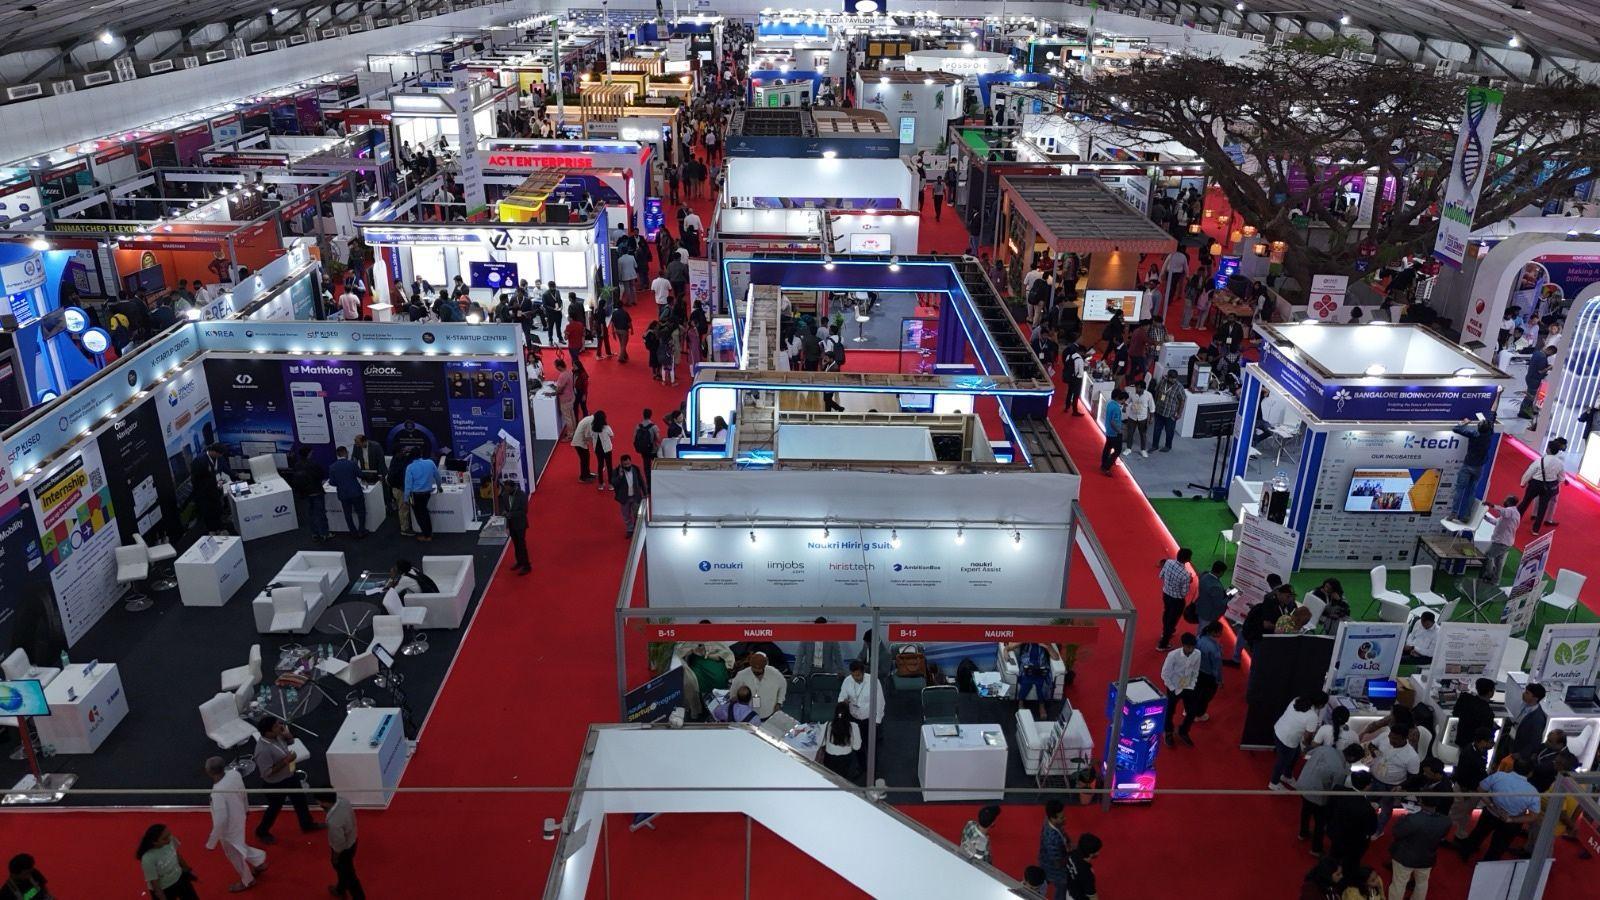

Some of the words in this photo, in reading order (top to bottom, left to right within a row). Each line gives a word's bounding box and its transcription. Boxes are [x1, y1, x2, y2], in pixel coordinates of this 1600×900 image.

[488, 156, 514, 166] ACT
[515, 157, 593, 168] ENTERPRISE
[54, 225, 107, 233] UNMATCHED
[518, 235, 570, 246] ZINTLR
[301, 366, 353, 376] Mathkong
[21, 433, 41, 452] KISED
[1404, 435, 1459, 449] K-tech
[42, 473, 85, 507] Internship
[841, 541, 870, 551] Hiring
[713, 561, 743, 569] naukri
[767, 561, 804, 571] iimjobs
[658, 629, 675, 637] B-15
[743, 629, 773, 637] NAUKRI
[900, 629, 917, 637] B-15
[985, 630, 1014, 638] NAUKRI
[1552, 671, 1581, 679] Anabio
